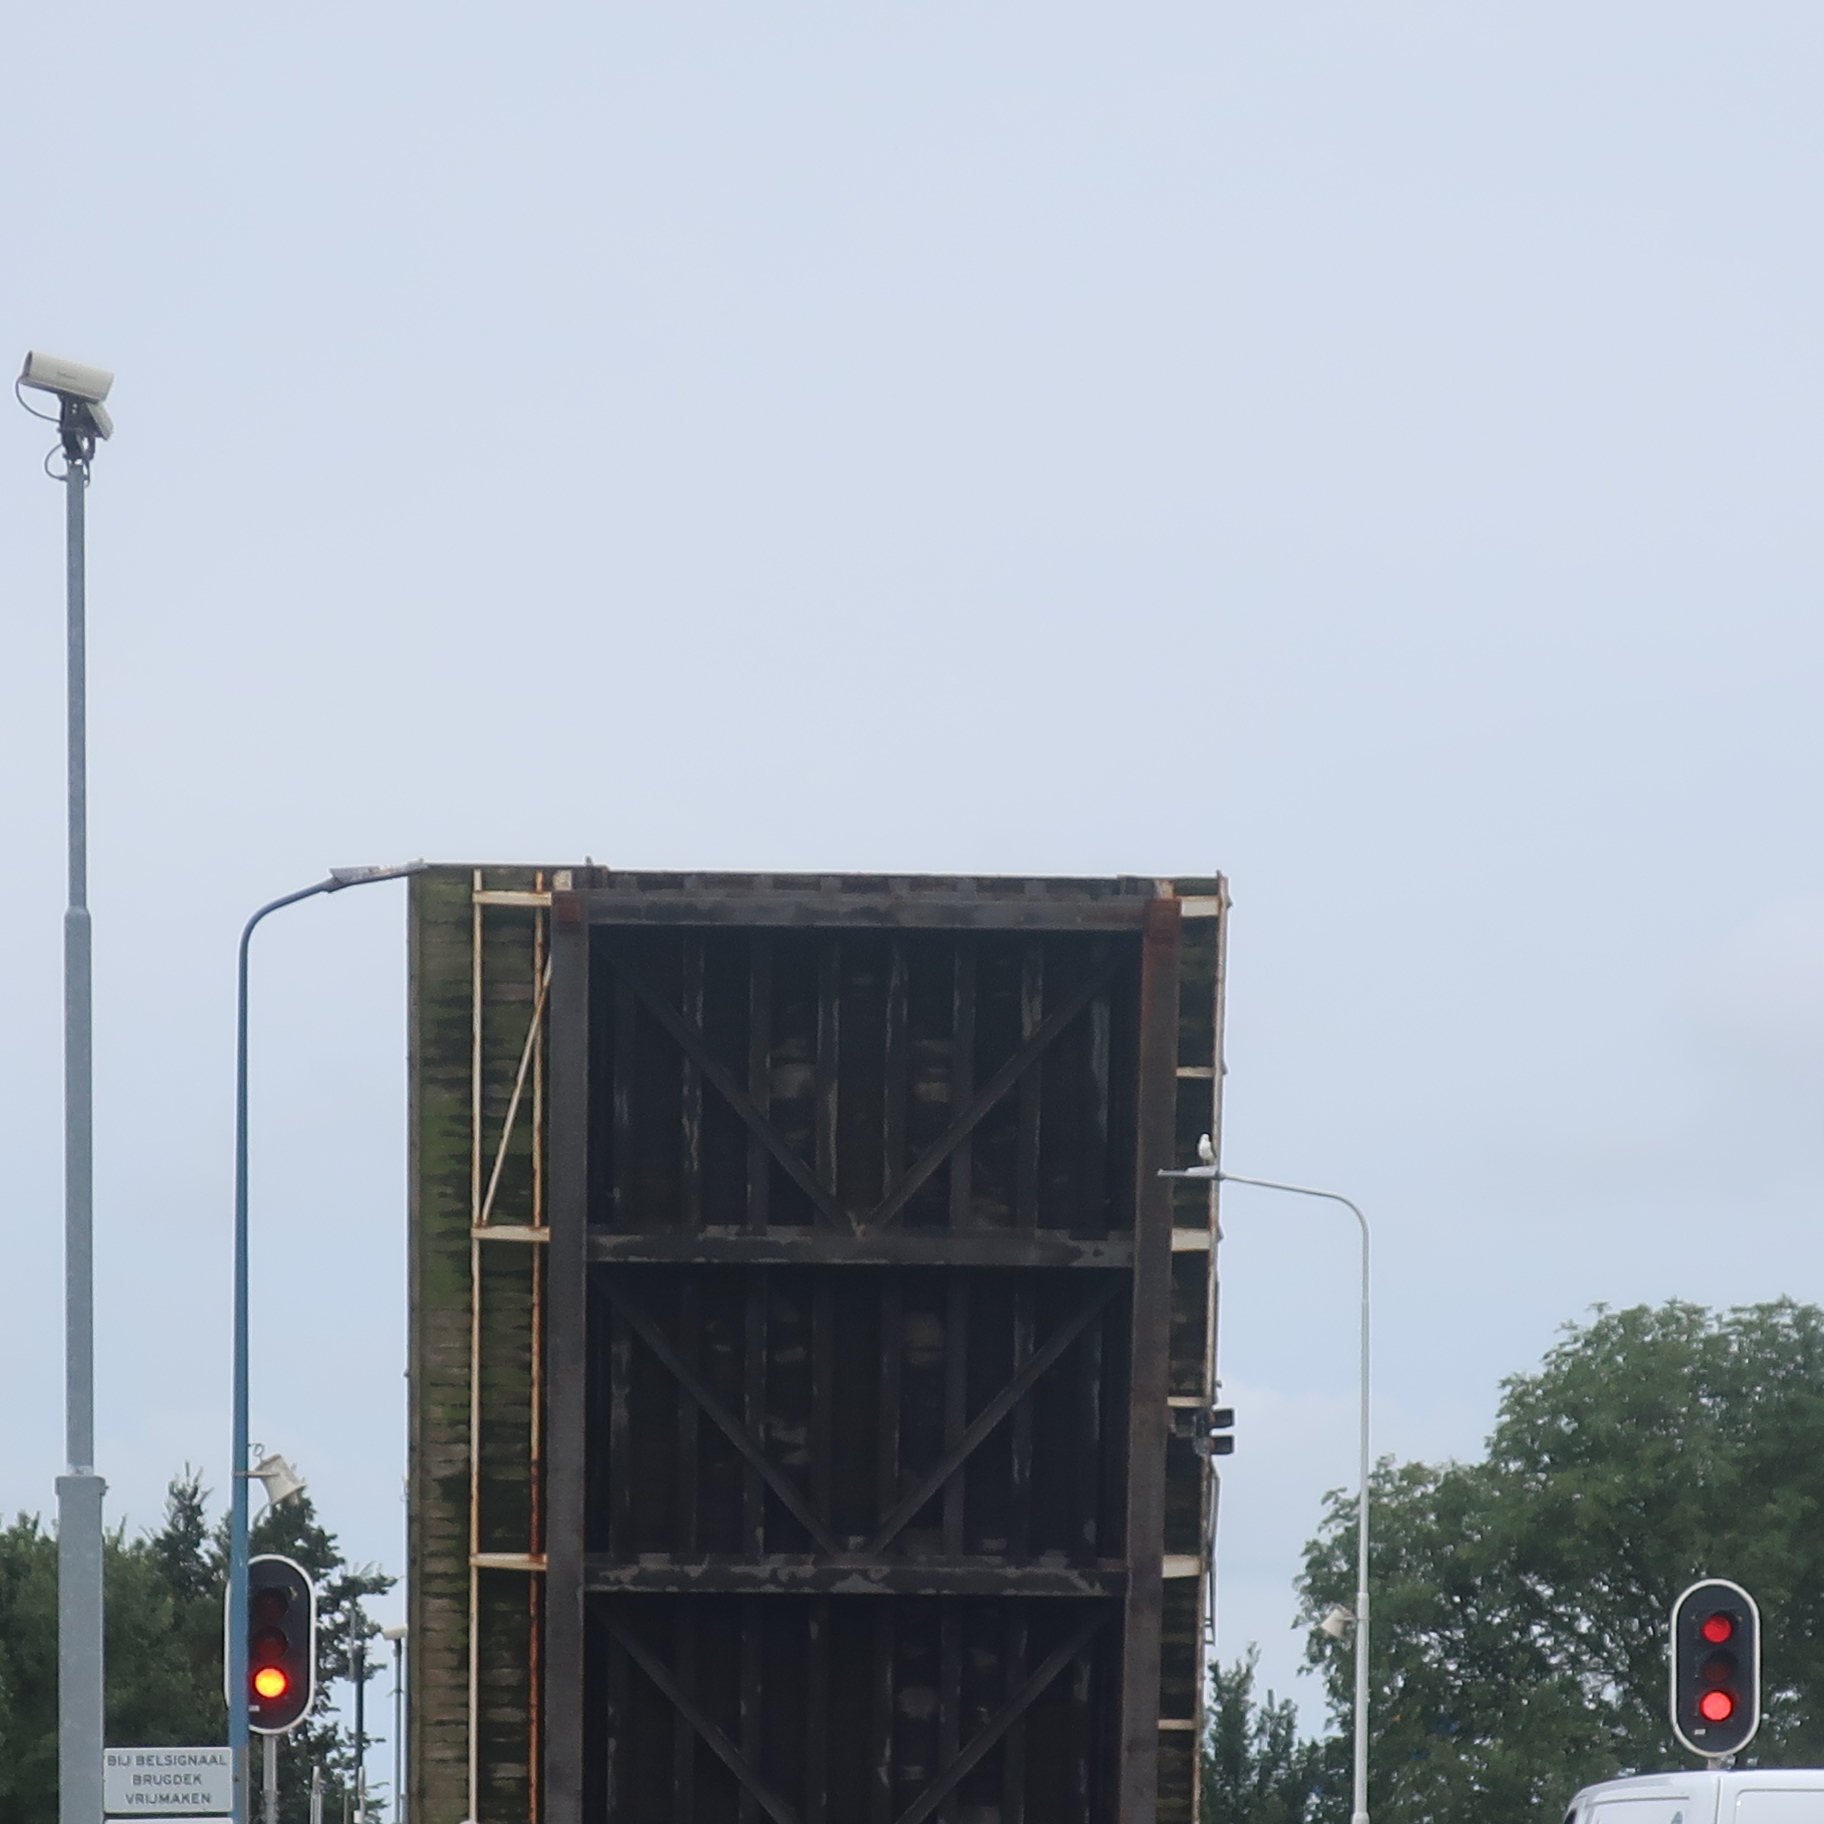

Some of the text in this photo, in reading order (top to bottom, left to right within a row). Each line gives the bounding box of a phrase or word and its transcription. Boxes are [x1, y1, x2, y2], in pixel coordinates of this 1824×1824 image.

[107, 1755, 227, 1767] BIJ BELSIGNAAL
[132, 1774, 202, 1786] BRUGDEK
[125, 1793, 211, 1805] VRIJMAKEN
